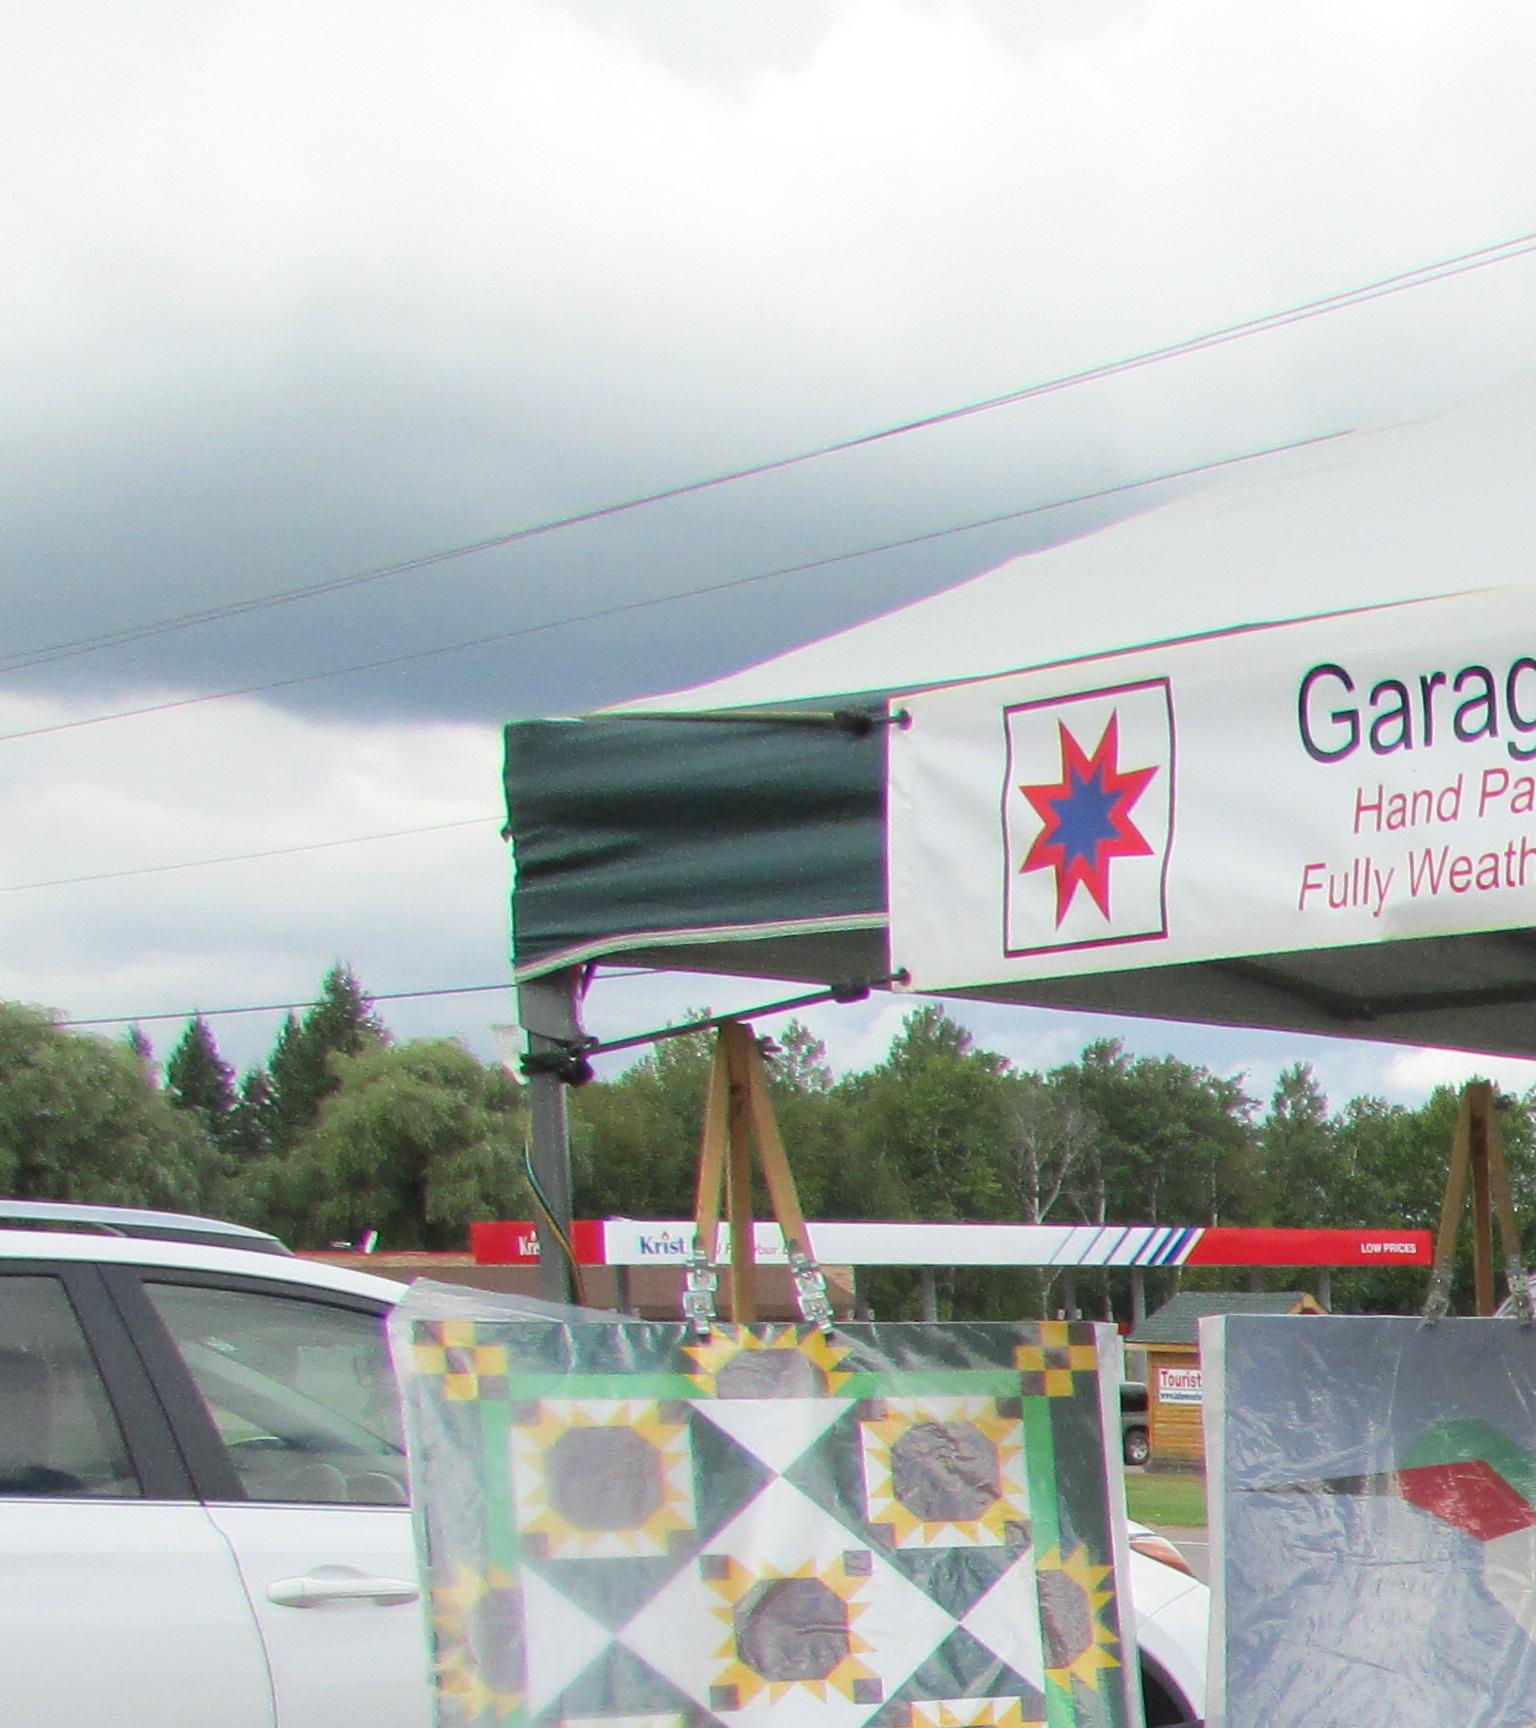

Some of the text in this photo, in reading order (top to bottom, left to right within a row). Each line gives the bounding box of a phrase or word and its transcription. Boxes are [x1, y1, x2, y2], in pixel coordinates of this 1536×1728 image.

[1352, 772, 1464, 835] Hand
[1297, 856, 1395, 919] Fully
[518, 1231, 541, 1256] Kri
[638, 1231, 687, 1255] Krist
[1160, 1370, 1202, 1388] Tourist
